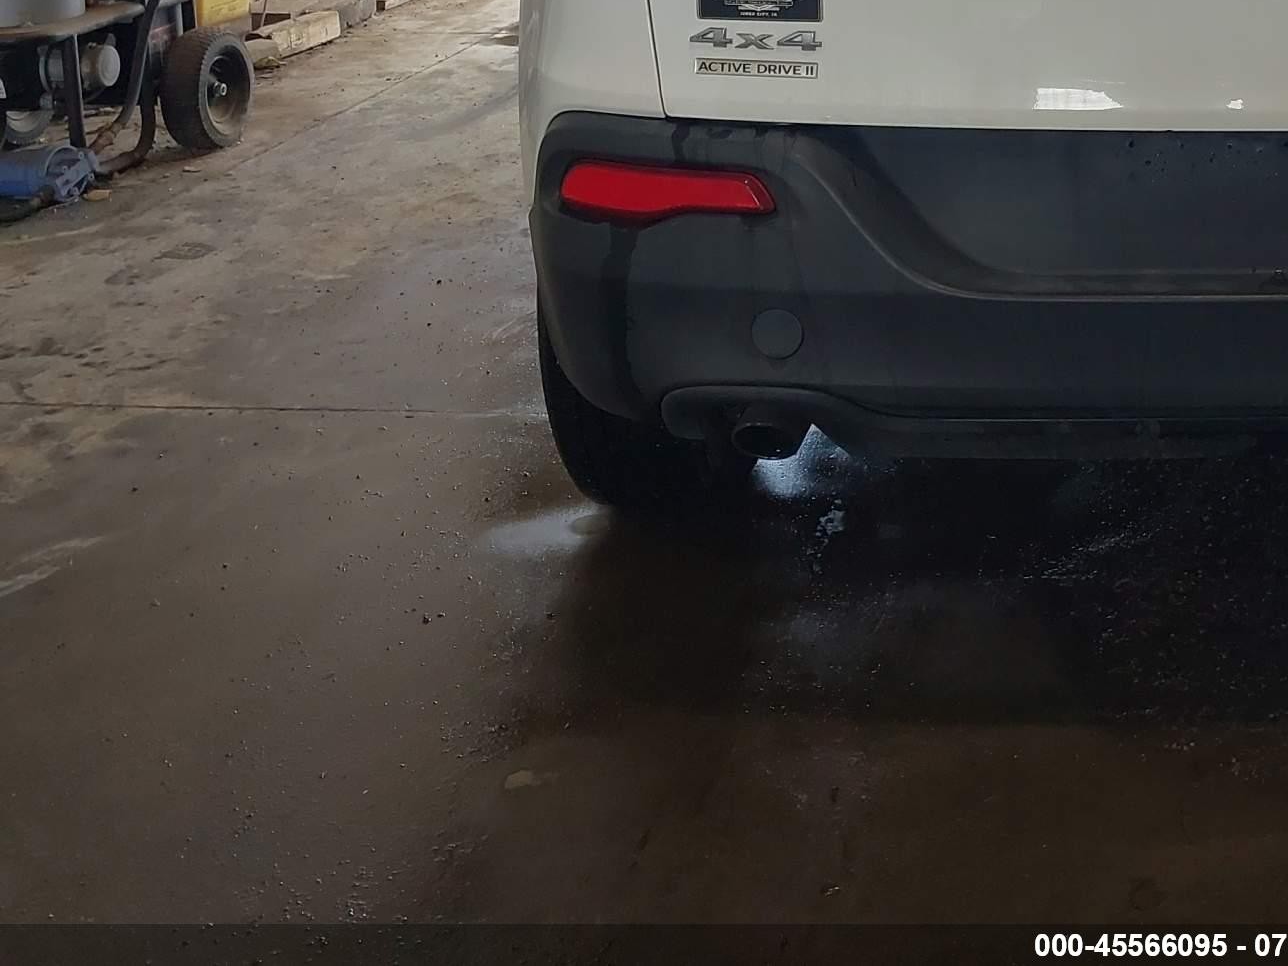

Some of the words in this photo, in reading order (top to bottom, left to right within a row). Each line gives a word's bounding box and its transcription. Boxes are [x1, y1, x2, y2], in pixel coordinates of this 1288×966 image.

[689, 27, 823, 51] 4x4
[698, 61, 752, 74] ACTIVE
[757, 63, 801, 75] DRIVE
